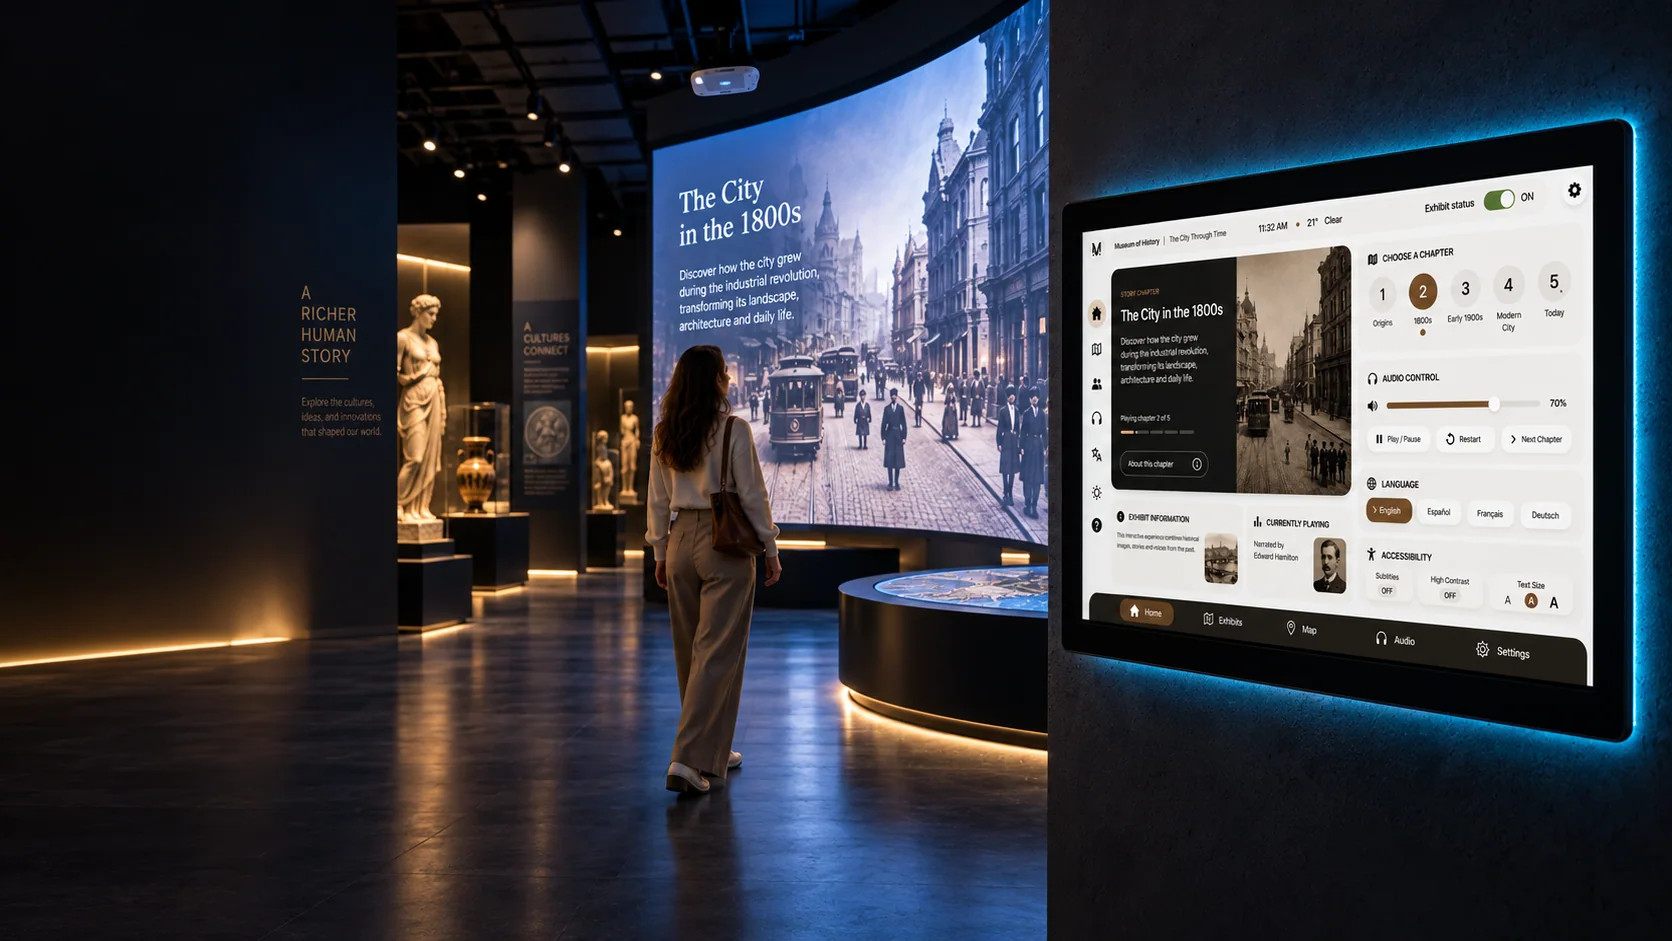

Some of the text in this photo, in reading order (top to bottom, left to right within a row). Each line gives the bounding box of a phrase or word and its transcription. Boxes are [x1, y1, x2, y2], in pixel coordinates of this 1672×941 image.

[679, 178, 764, 214] The City
[1521, 192, 1534, 202] ON
[1425, 200, 1475, 213] Exhibit status
[680, 202, 801, 246] in the 1800s
[1307, 217, 1318, 228] 21°
[1324, 216, 1343, 225] Clear
[1259, 221, 1288, 232] 11:32 AM
[1191, 231, 1212, 240] Through
[1115, 242, 1135, 250] Museum
[1382, 248, 1454, 263] CHOOSE A CHAPTER
[680, 252, 802, 281] Discover how the city grew
[680, 267, 820, 298] during the industrial revolution,
[1504, 278, 1513, 291] 4
[301, 286, 311, 300] A
[1419, 285, 1427, 298] 2
[1461, 282, 1470, 295] 3
[1380, 288, 1385, 301] 1
[680, 290, 799, 314] transforming its landscape,
[302, 307, 357, 322] RICHER
[1121, 303, 1224, 323] The City in the 1800s
[1497, 312, 1522, 320] Modern
[1545, 309, 1565, 318] Today
[680, 308, 794, 332] architecture and daily life.
[1414, 317, 1433, 325] 1800s
[1448, 314, 1483, 323] Early 1900s
[524, 322, 532, 332] A
[1373, 320, 1393, 328] Origins
[1502, 324, 1515, 333] City
[302, 328, 357, 342] HUMAN
[524, 333, 570, 343] CULTURES
[1121, 337, 1146, 346] Discover
[1160, 335, 1170, 344] the
[1171, 334, 1182, 344] city
[1183, 335, 1199, 344] grew
[302, 349, 351, 363] STORY
[524, 346, 568, 356] CONNECT
[1121, 350, 1139, 359] during
[1150, 348, 1178, 357] industrial
[1178, 346, 1209, 356] revolution,
[1121, 361, 1156, 372] transforming
[1121, 374, 1194, 384] architecture and daily life.
[1382, 373, 1440, 383] AUDIO CONTROL
[302, 397, 375, 409] Explore the cultures,
[1550, 399, 1567, 408] 70%
[302, 412, 382, 422] ideas, and innovations
[1121, 415, 1137, 423] Playing
[302, 428, 316, 436] that
[318, 427, 345, 438] shaped
[360, 427, 381, 436] world.
[1387, 436, 1399, 444] Play
[1538, 436, 1562, 445] Chapter
[1128, 460, 1174, 469] About this chapter
[1382, 480, 1419, 489] LANGUAGE
[1379, 506, 1401, 515] English
[1428, 508, 1451, 518] Español
[1477, 510, 1504, 519] Français
[1532, 511, 1559, 520] Deutsch
[1150, 515, 1190, 523] INFORMATION
[1267, 519, 1330, 528] CURRENTLY PLAYING
[1278, 542, 1284, 550] by
[1254, 552, 1299, 561] Edward Hamilton
[1381, 552, 1432, 562] ACCESSIBILITY
[1431, 576, 1470, 585] High Contrast
[1517, 581, 1545, 590] Text Size
[1505, 596, 1511, 605] A
[1550, 597, 1559, 609] A
[1145, 608, 1163, 618] Home
[1219, 616, 1243, 627] Exhibits
[1302, 625, 1317, 636] Map
[1394, 636, 1415, 646] Audio
[1497, 647, 1530, 660] Settings
